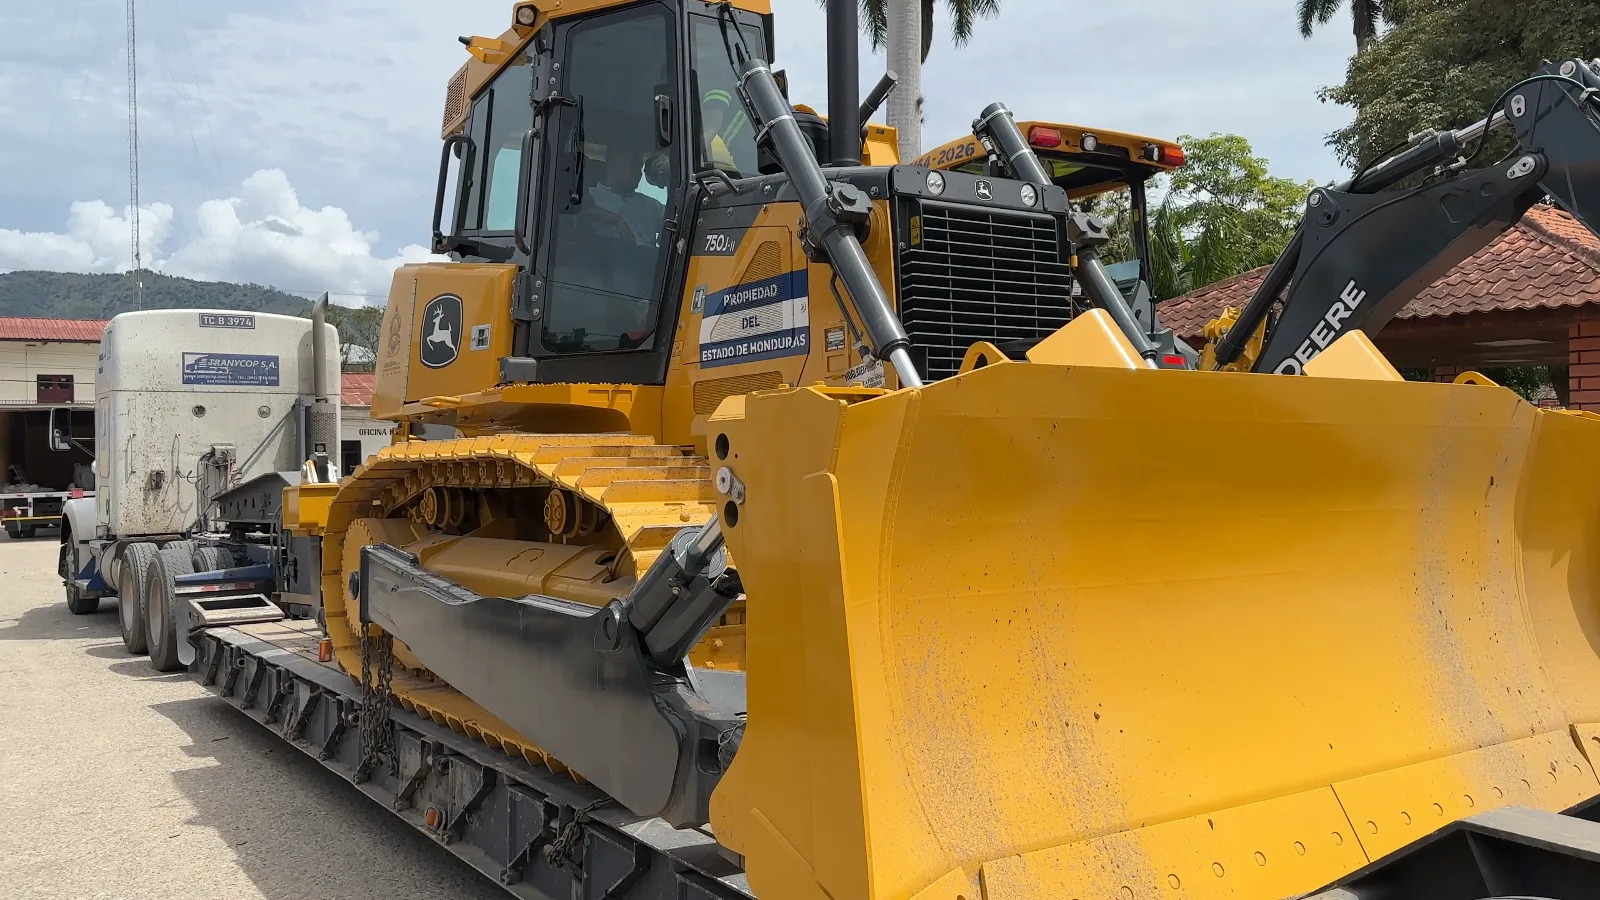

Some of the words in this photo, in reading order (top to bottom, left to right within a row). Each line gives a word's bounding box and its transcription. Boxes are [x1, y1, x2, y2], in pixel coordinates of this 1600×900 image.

[723, 283, 778, 307] PROPIEDAD
[203, 316, 215, 325] TC
[218, 316, 225, 325] B
[227, 317, 252, 326] 3974
[742, 315, 760, 330] DEL
[702, 345, 735, 362] ESTADO
[736, 342, 748, 356] DE
[750, 333, 806, 354] HONDURAS
[208, 358, 259, 368] TRANYCOP
[260, 360, 278, 369] S.A.
[359, 428, 388, 436] OFICINA
